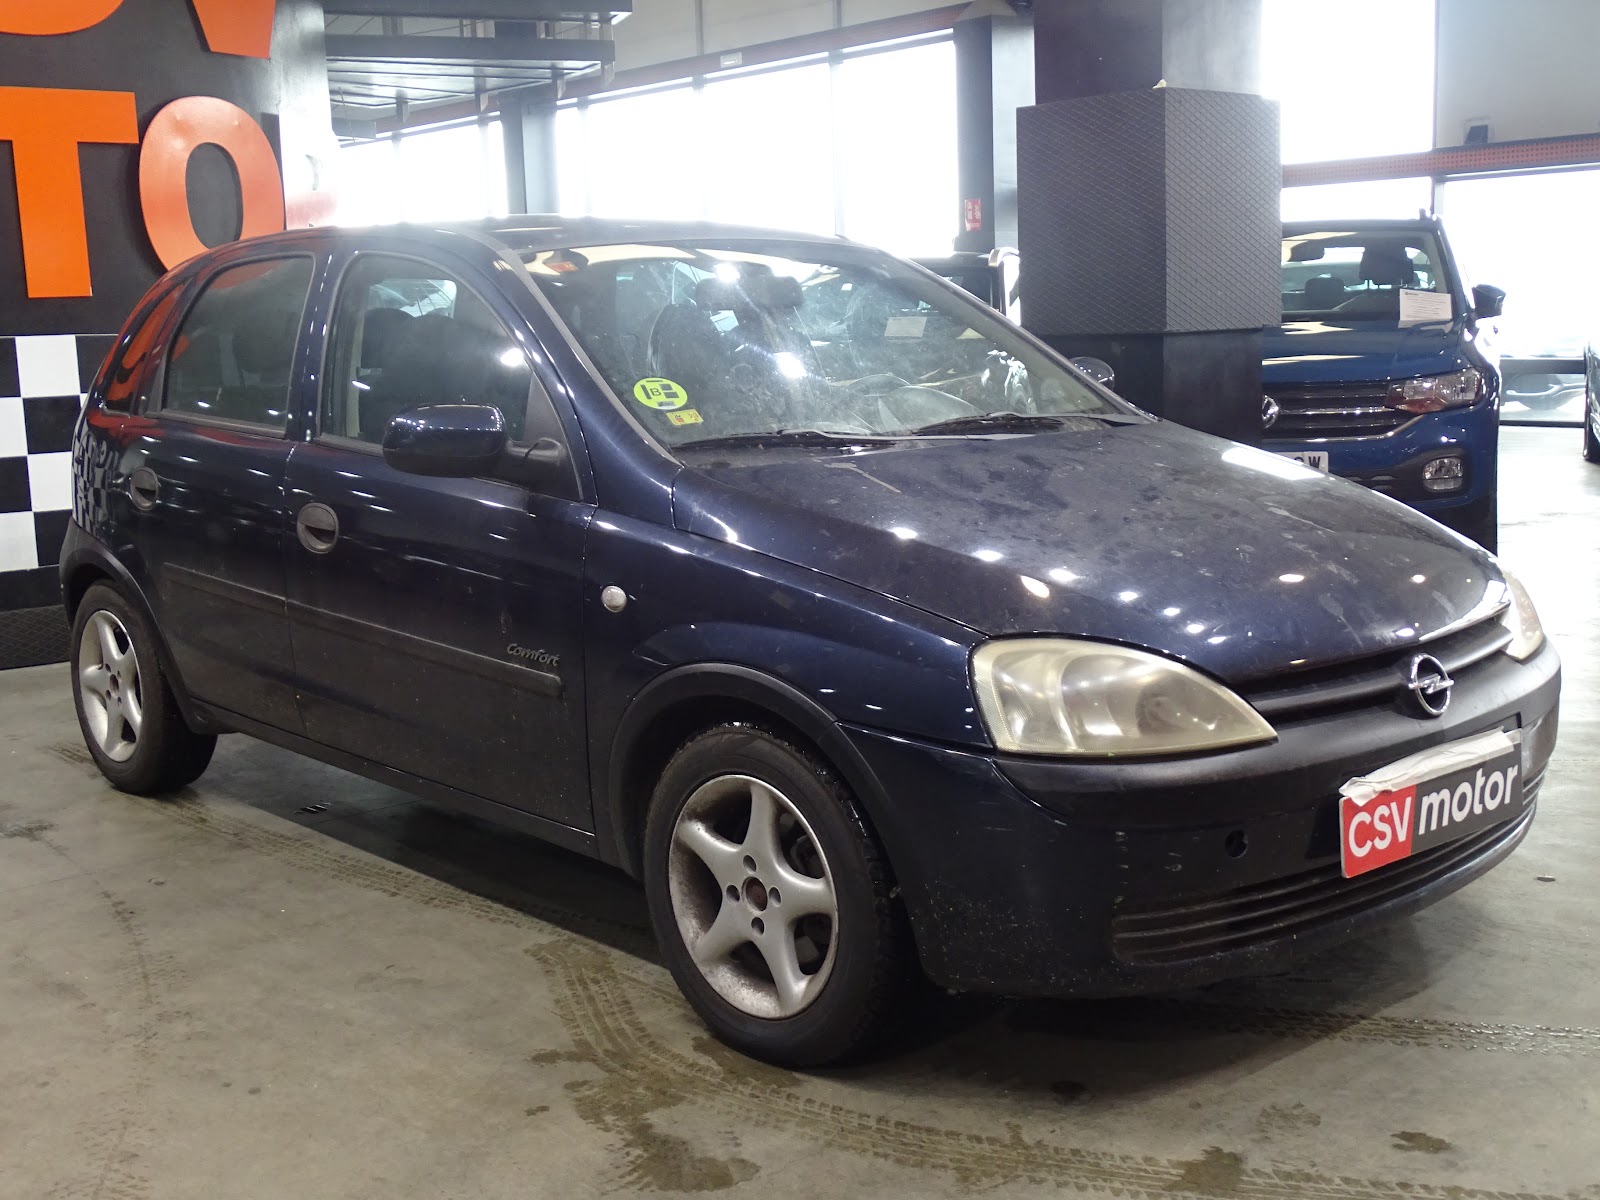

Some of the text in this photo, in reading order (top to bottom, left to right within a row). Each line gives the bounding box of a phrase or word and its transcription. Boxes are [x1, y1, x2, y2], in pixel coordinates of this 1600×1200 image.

[650, 387, 661, 396] B
[506, 643, 560, 667] Comfort
[1348, 764, 1518, 857] CSV motor
